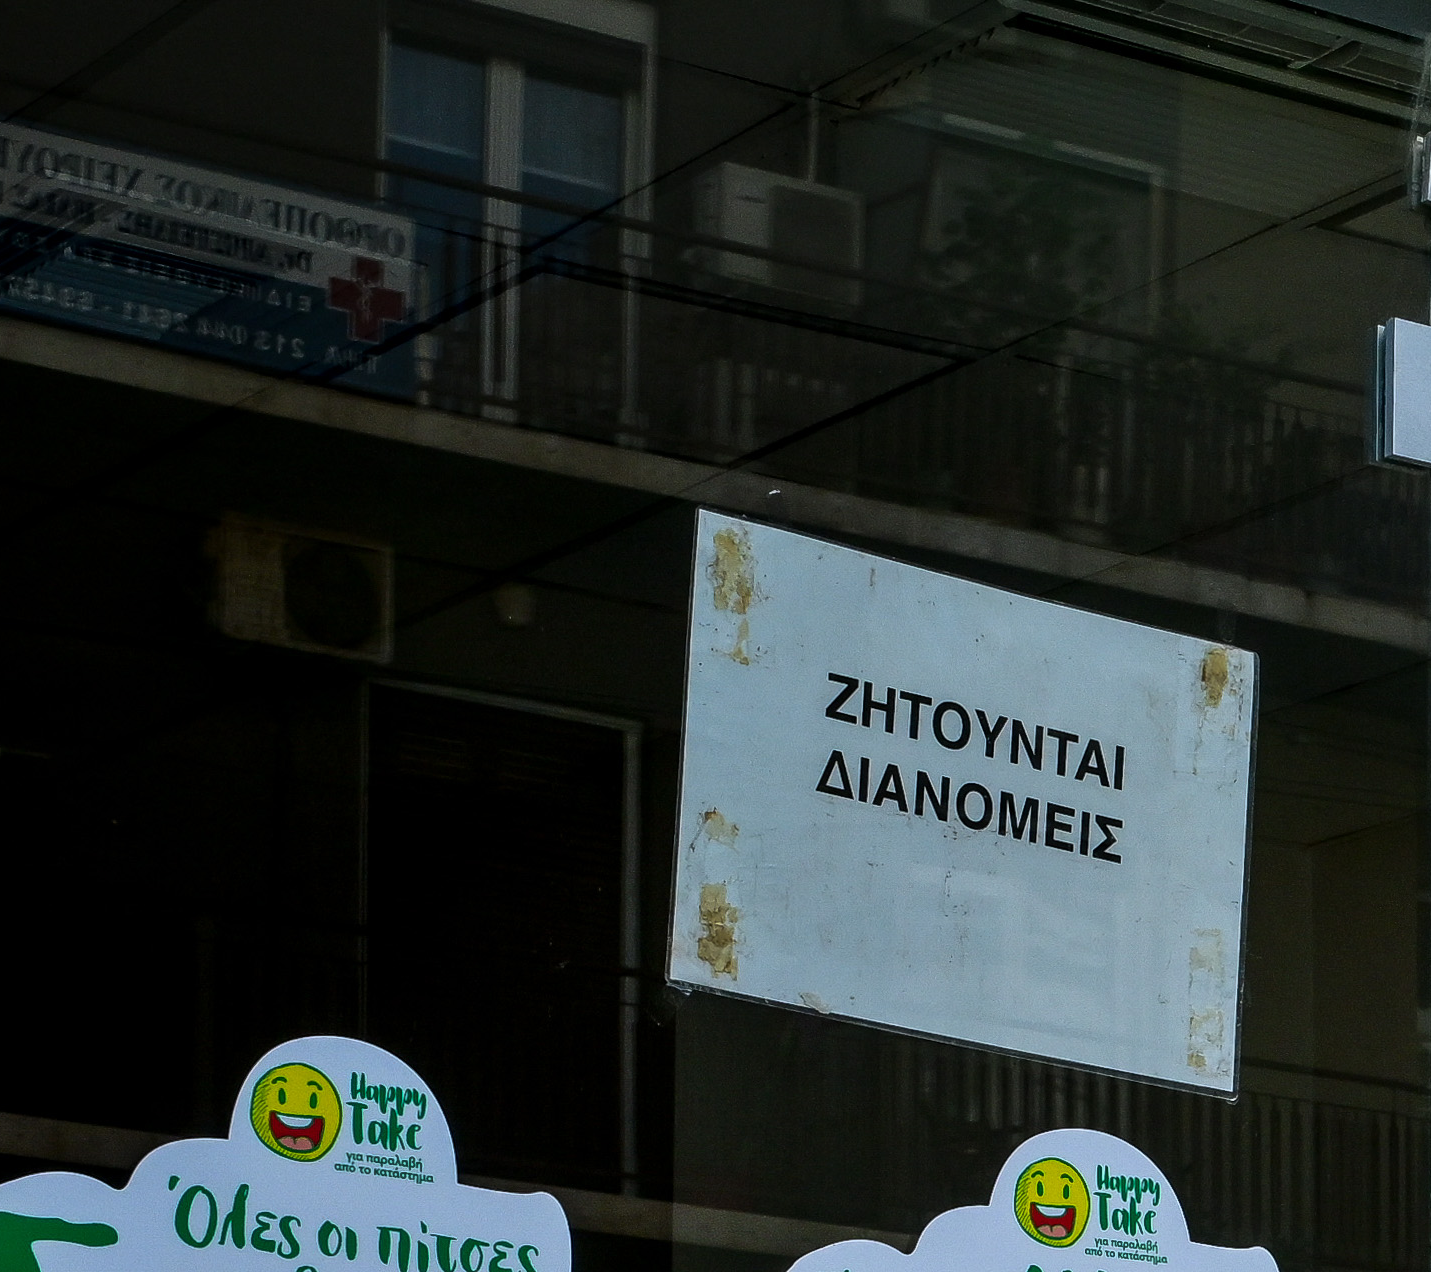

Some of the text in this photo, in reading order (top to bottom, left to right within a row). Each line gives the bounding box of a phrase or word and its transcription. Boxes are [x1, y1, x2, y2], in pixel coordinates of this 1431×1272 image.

[825, 673, 1124, 790] ΖΗΤΟΥΝΤΑΙ
[816, 749, 1123, 864] ΔΙΑΝΟΜΕΙΣ
[351, 1072, 426, 1119] Happy
[346, 1102, 421, 1151] Take
[334, 1162, 433, 1184] από το κατάστημα
[366, 1155, 422, 1172] παραλαβή
[1097, 1165, 1160, 1206] Happy
[1093, 1192, 1157, 1236] Take
[318, 1221, 357, 1260] οι
[1085, 1246, 1102, 1256] από
[1118, 1251, 1167, 1265] κατάστημα
[1111, 1239, 1158, 1254] παραλαβή
